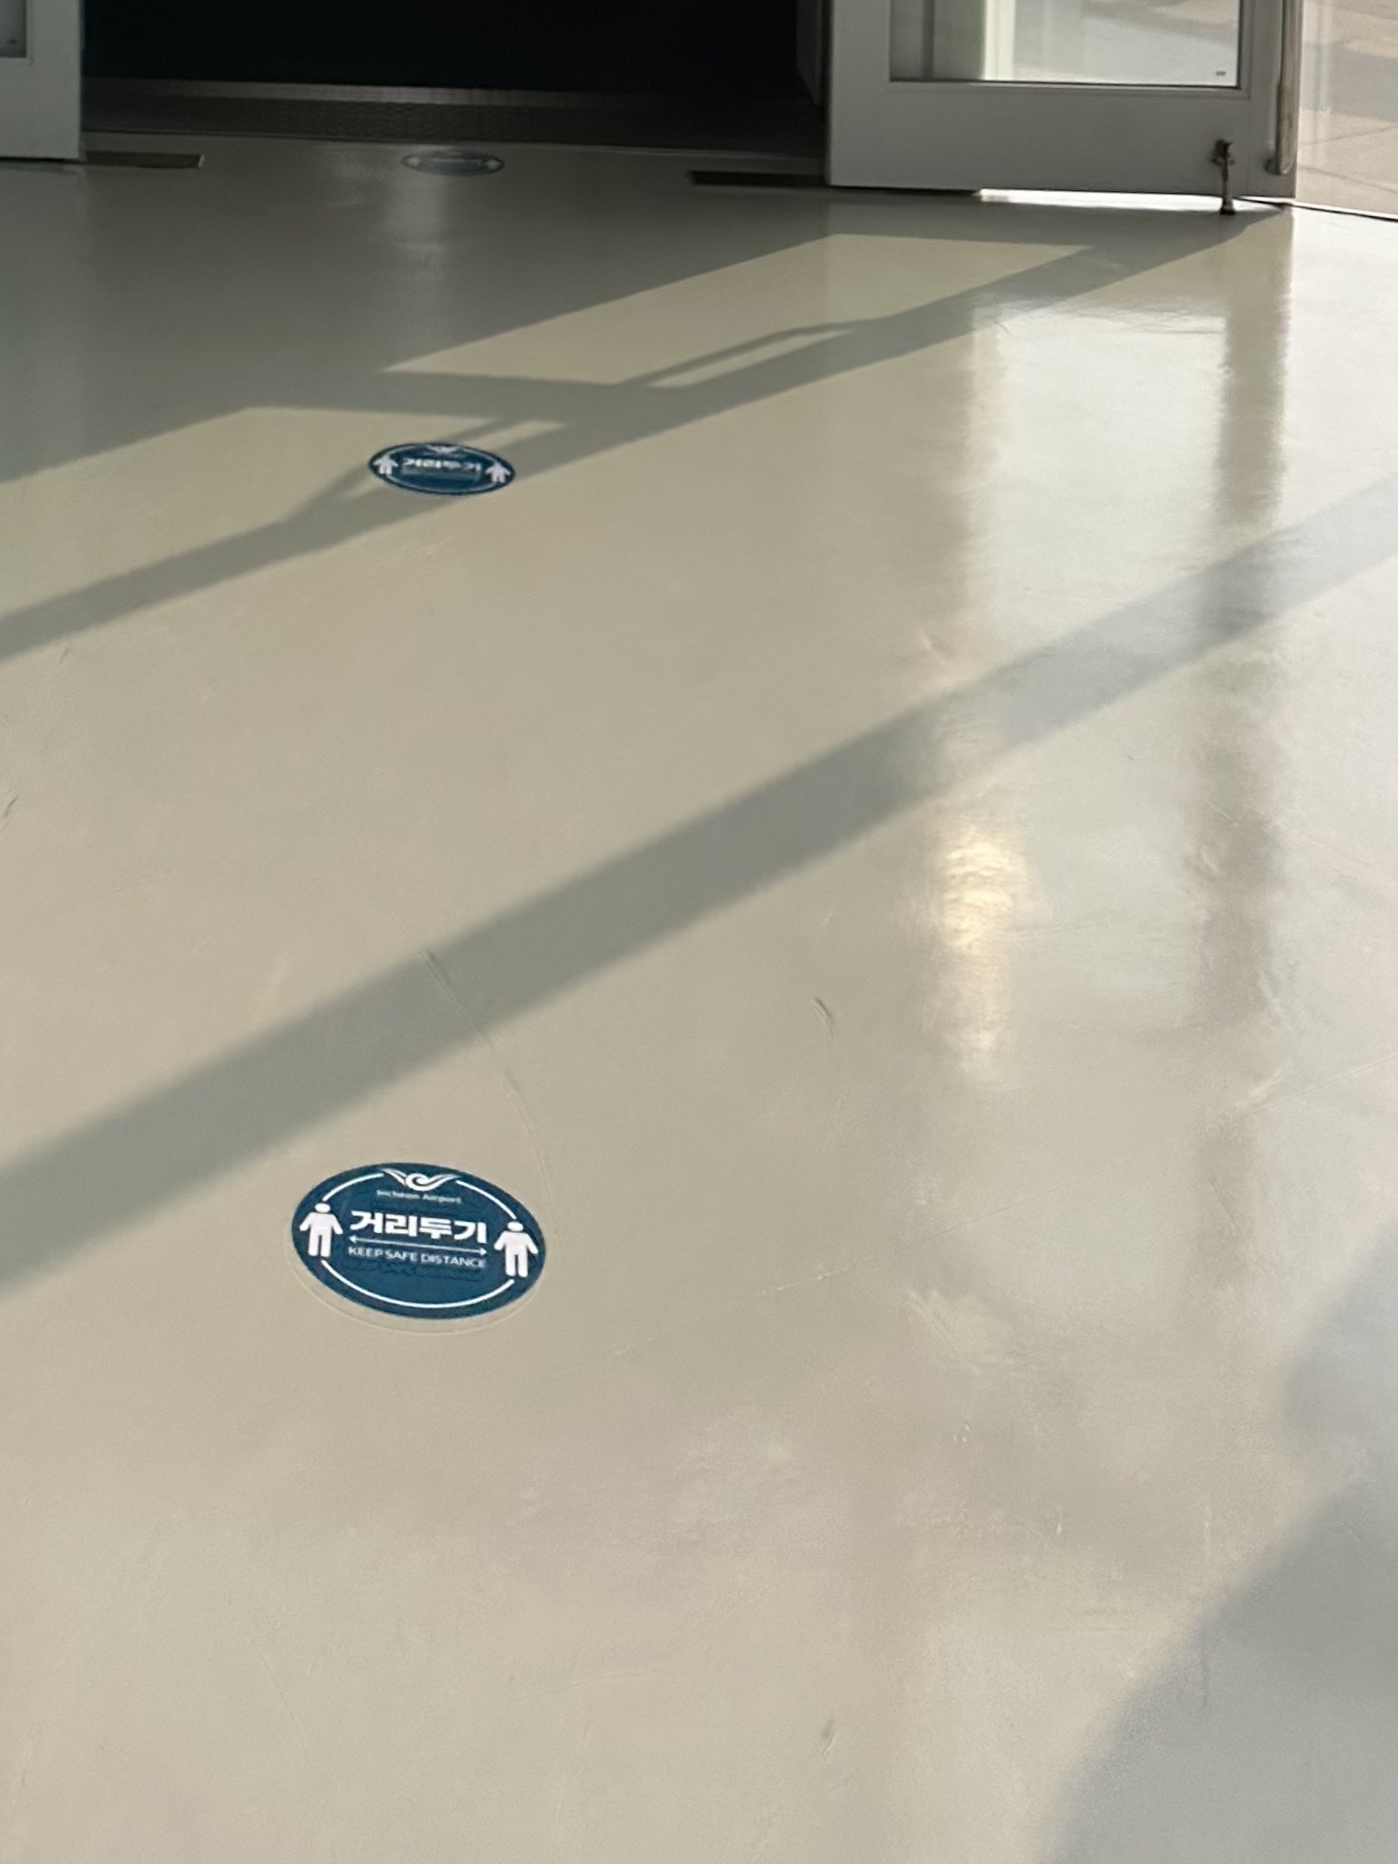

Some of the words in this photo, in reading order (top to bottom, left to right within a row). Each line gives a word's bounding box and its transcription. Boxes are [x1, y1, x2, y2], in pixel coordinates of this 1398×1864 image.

[349, 1209, 488, 1244] 거리두기
[347, 1245, 383, 1258] KEEP
[384, 1248, 418, 1263] SAFE
[420, 1252, 487, 1270] DISTANCE
